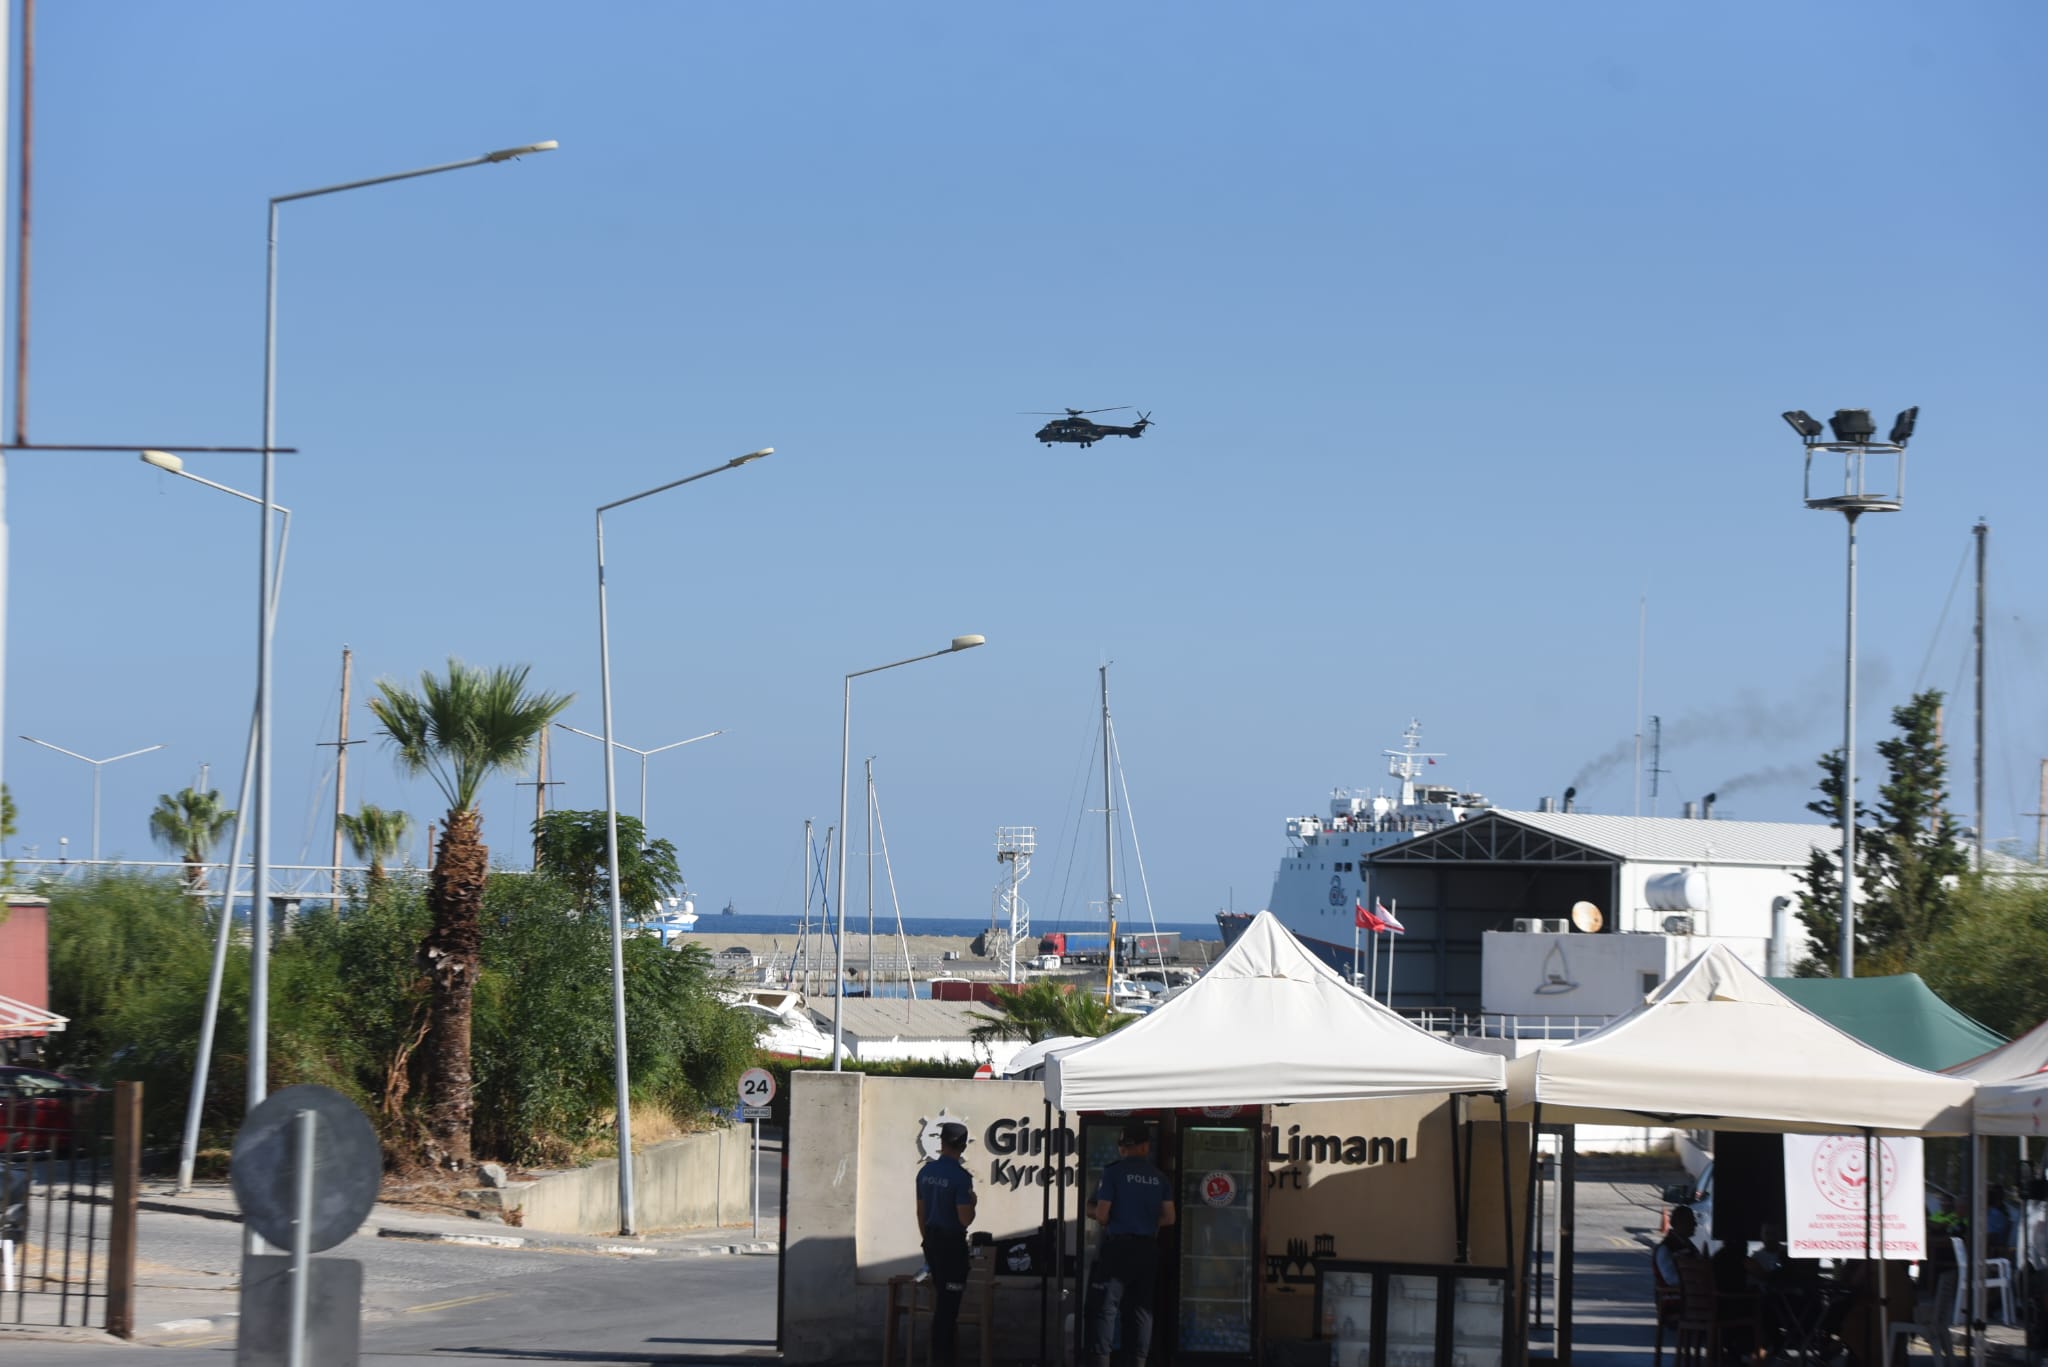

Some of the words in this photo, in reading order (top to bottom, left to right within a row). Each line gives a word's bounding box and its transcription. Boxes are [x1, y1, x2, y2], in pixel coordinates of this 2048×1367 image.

[745, 1080, 769, 1095] 24
[984, 1116, 1079, 1155] Girn
[1271, 1124, 1408, 1165] Limanı
